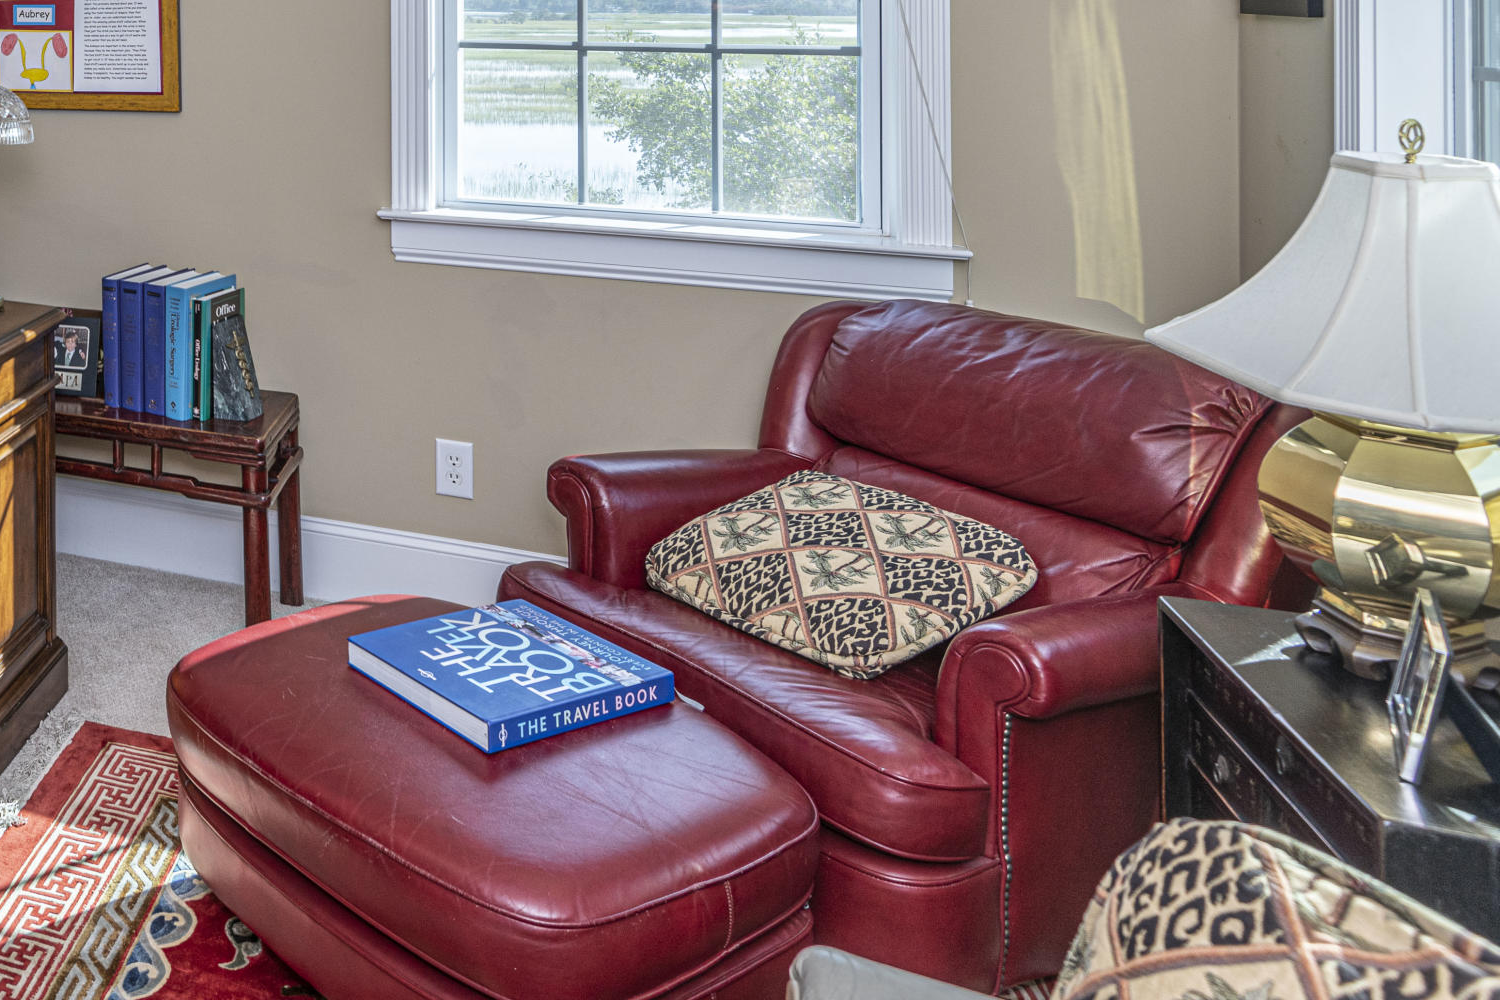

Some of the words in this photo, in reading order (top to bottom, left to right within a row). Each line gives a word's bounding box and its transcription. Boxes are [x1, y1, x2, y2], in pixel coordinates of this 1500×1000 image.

[19, 10, 50, 21] Aubrey
[215, 304, 236, 317] Office
[513, 608, 570, 637] THROUGH
[551, 620, 566, 630] THE
[426, 618, 571, 701] TRAVEL
[440, 611, 615, 694] BOOK
[571, 636, 626, 665] JOURNEY
[579, 634, 622, 656] COUNTRY
[420, 644, 513, 693] THE
[518, 716, 548, 738] THE
[553, 700, 609, 729] TRAVEL
[615, 685, 658, 710] BOOK
